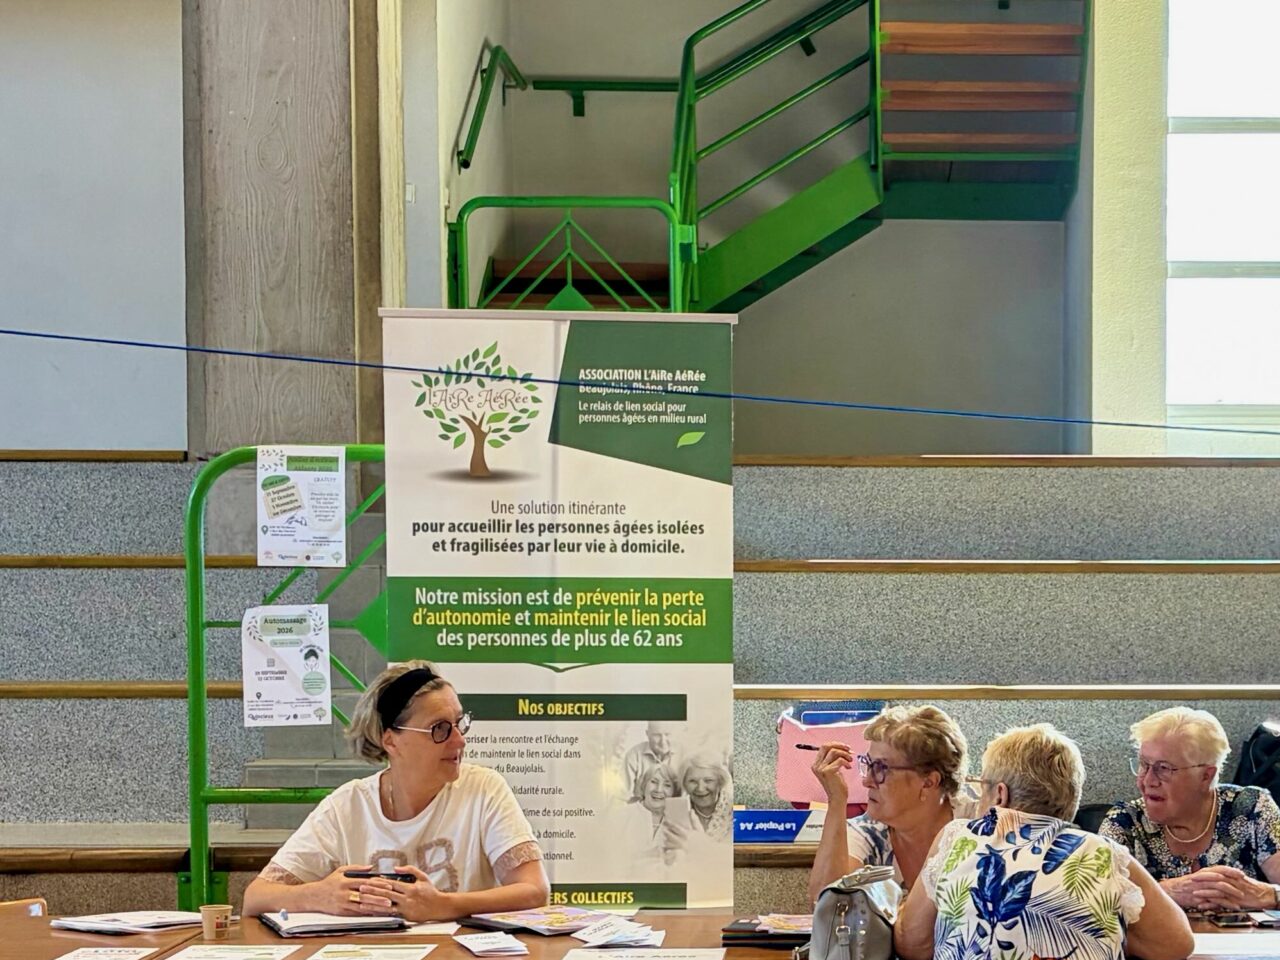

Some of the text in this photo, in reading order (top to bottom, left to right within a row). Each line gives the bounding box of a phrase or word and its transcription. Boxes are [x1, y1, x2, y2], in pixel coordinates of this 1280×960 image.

[579, 369, 706, 381] ASSOCIATION L'AiRe AéRée
[668, 383, 699, 393] France
[579, 401, 686, 413] Le relais de lien social pour
[579, 414, 620, 424] personnes
[622, 413, 646, 424] âgées
[659, 413, 685, 423] milieu
[687, 413, 707, 423] rural
[491, 501, 626, 514] Une solution itinérante
[412, 520, 704, 537] pour accueillir les personnes âgées isolées
[432, 539, 685, 556] et fragilisées par leur vie à domicile.
[415, 588, 704, 609] Notre mission est de prévenir la perte
[413, 608, 706, 625] d'autonomie et maintenir le lien social
[437, 630, 683, 650] des personnes de plus de 62 ans
[490, 736, 497, 744] la
[499, 736, 534, 744] rencontre
[535, 736, 542, 744] et
[544, 736, 579, 746] l'échange
[470, 750, 478, 758] de
[480, 750, 516, 758] maintenir
[518, 750, 525, 758] le
[526, 750, 540, 758] lien
[542, 750, 562, 758] social
[564, 750, 581, 758] dans
[506, 764, 546, 774] Beaujolais.
[541, 787, 564, 795] rurale.
[542, 808, 552, 817] de
[554, 808, 563, 817] soi
[565, 809, 595, 818] positive.
[543, 830, 576, 839] domicile.
[572, 891, 634, 904] COLLECTIFS
